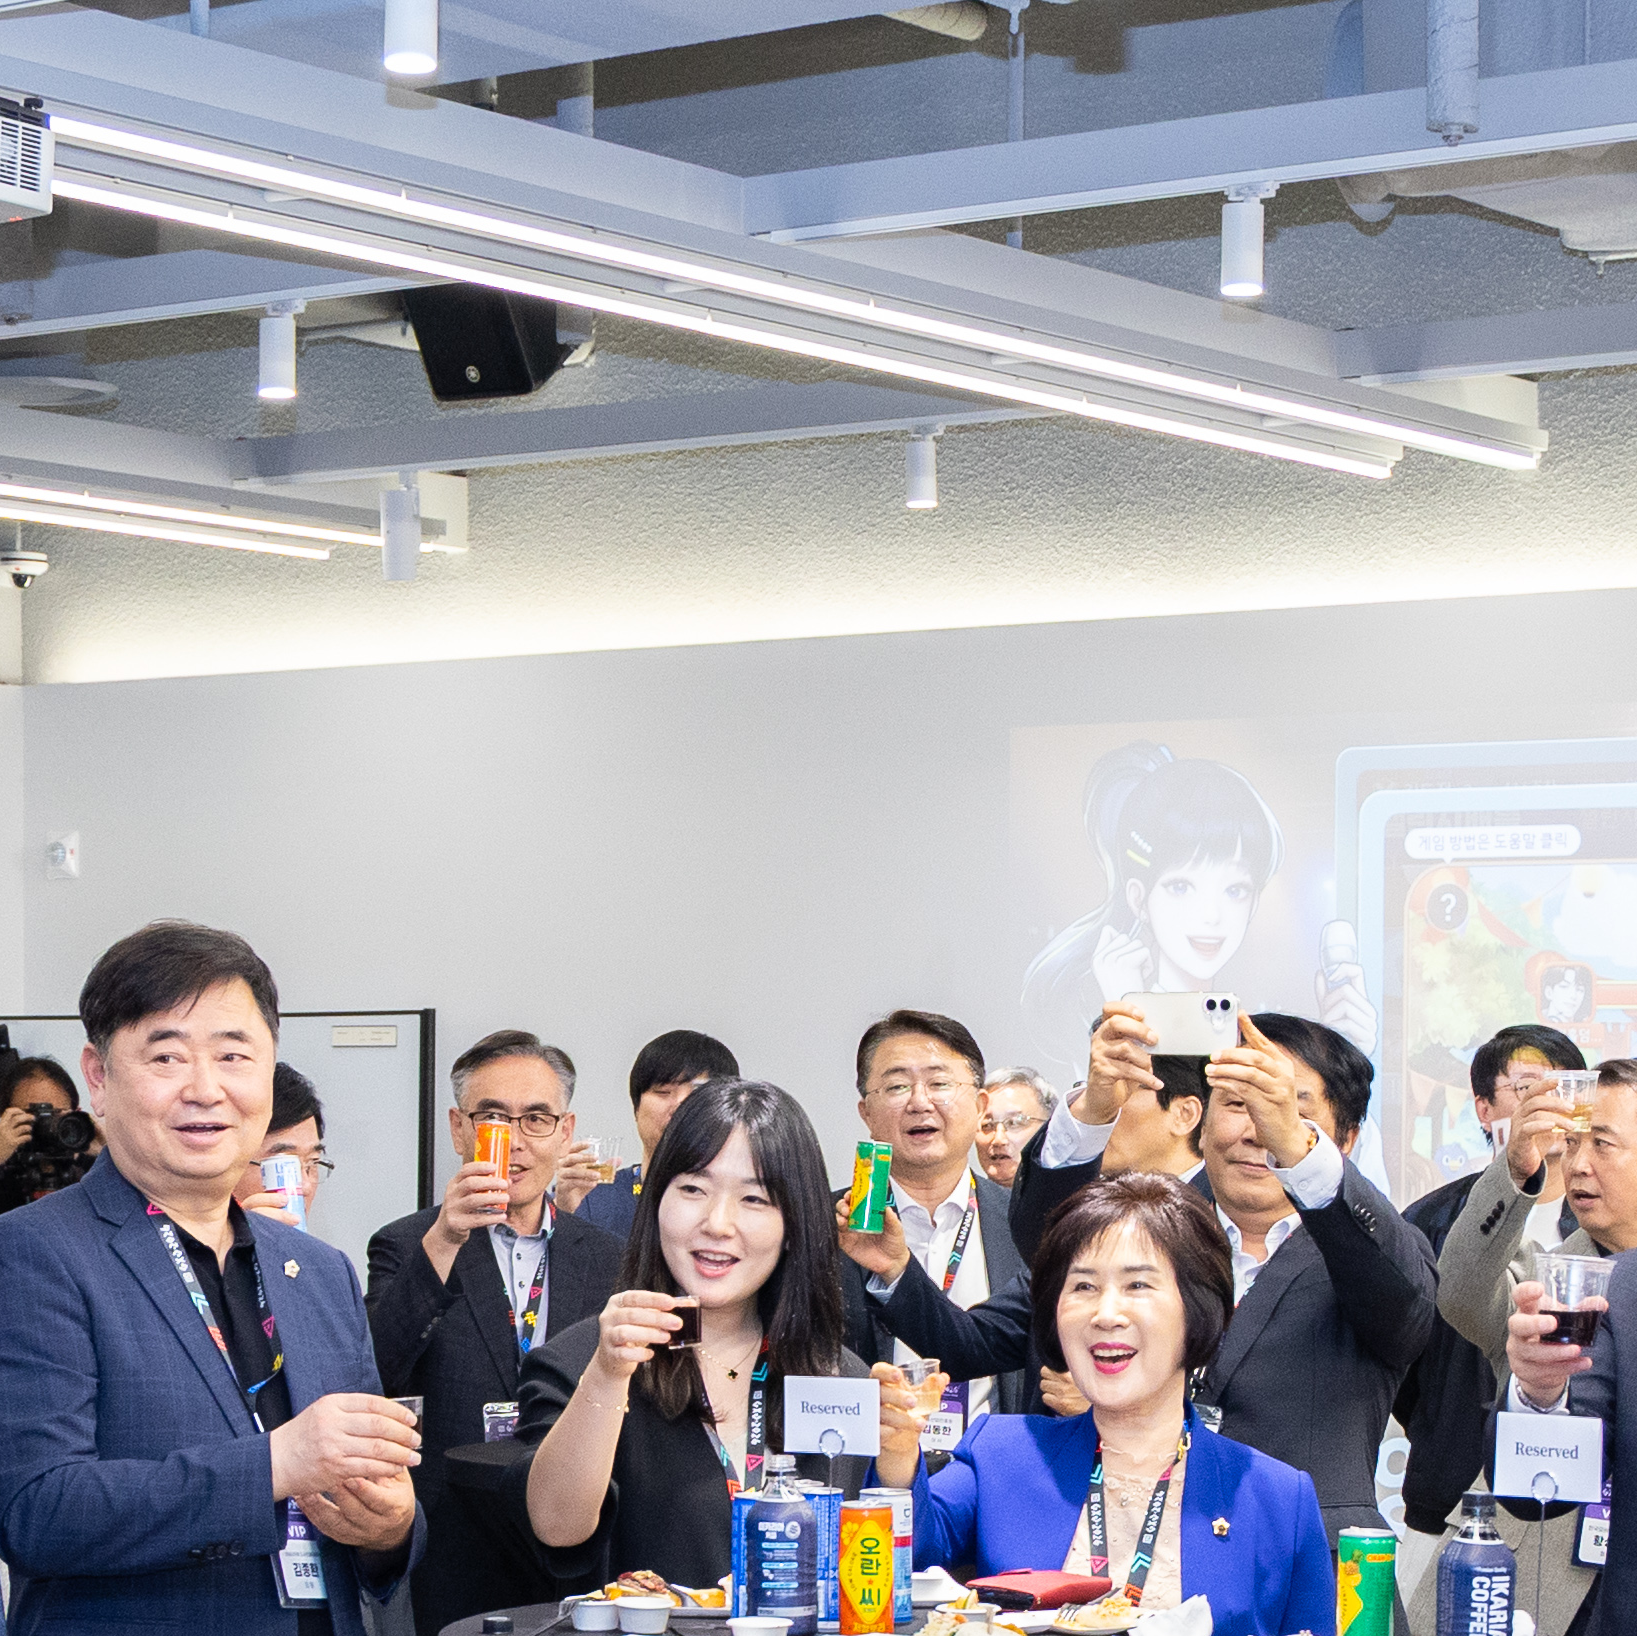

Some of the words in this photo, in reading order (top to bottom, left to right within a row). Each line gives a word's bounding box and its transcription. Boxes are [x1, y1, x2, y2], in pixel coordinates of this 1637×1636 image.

[1418, 834, 1445, 851] 게임
[1449, 834, 1489, 851] 방법은
[1494, 832, 1536, 849] 도움말
[1540, 831, 1568, 848] 클릭
[800, 1400, 861, 1416] Reserved
[1515, 1441, 1579, 1460] Reserved
[288, 1525, 307, 1538] VIP
